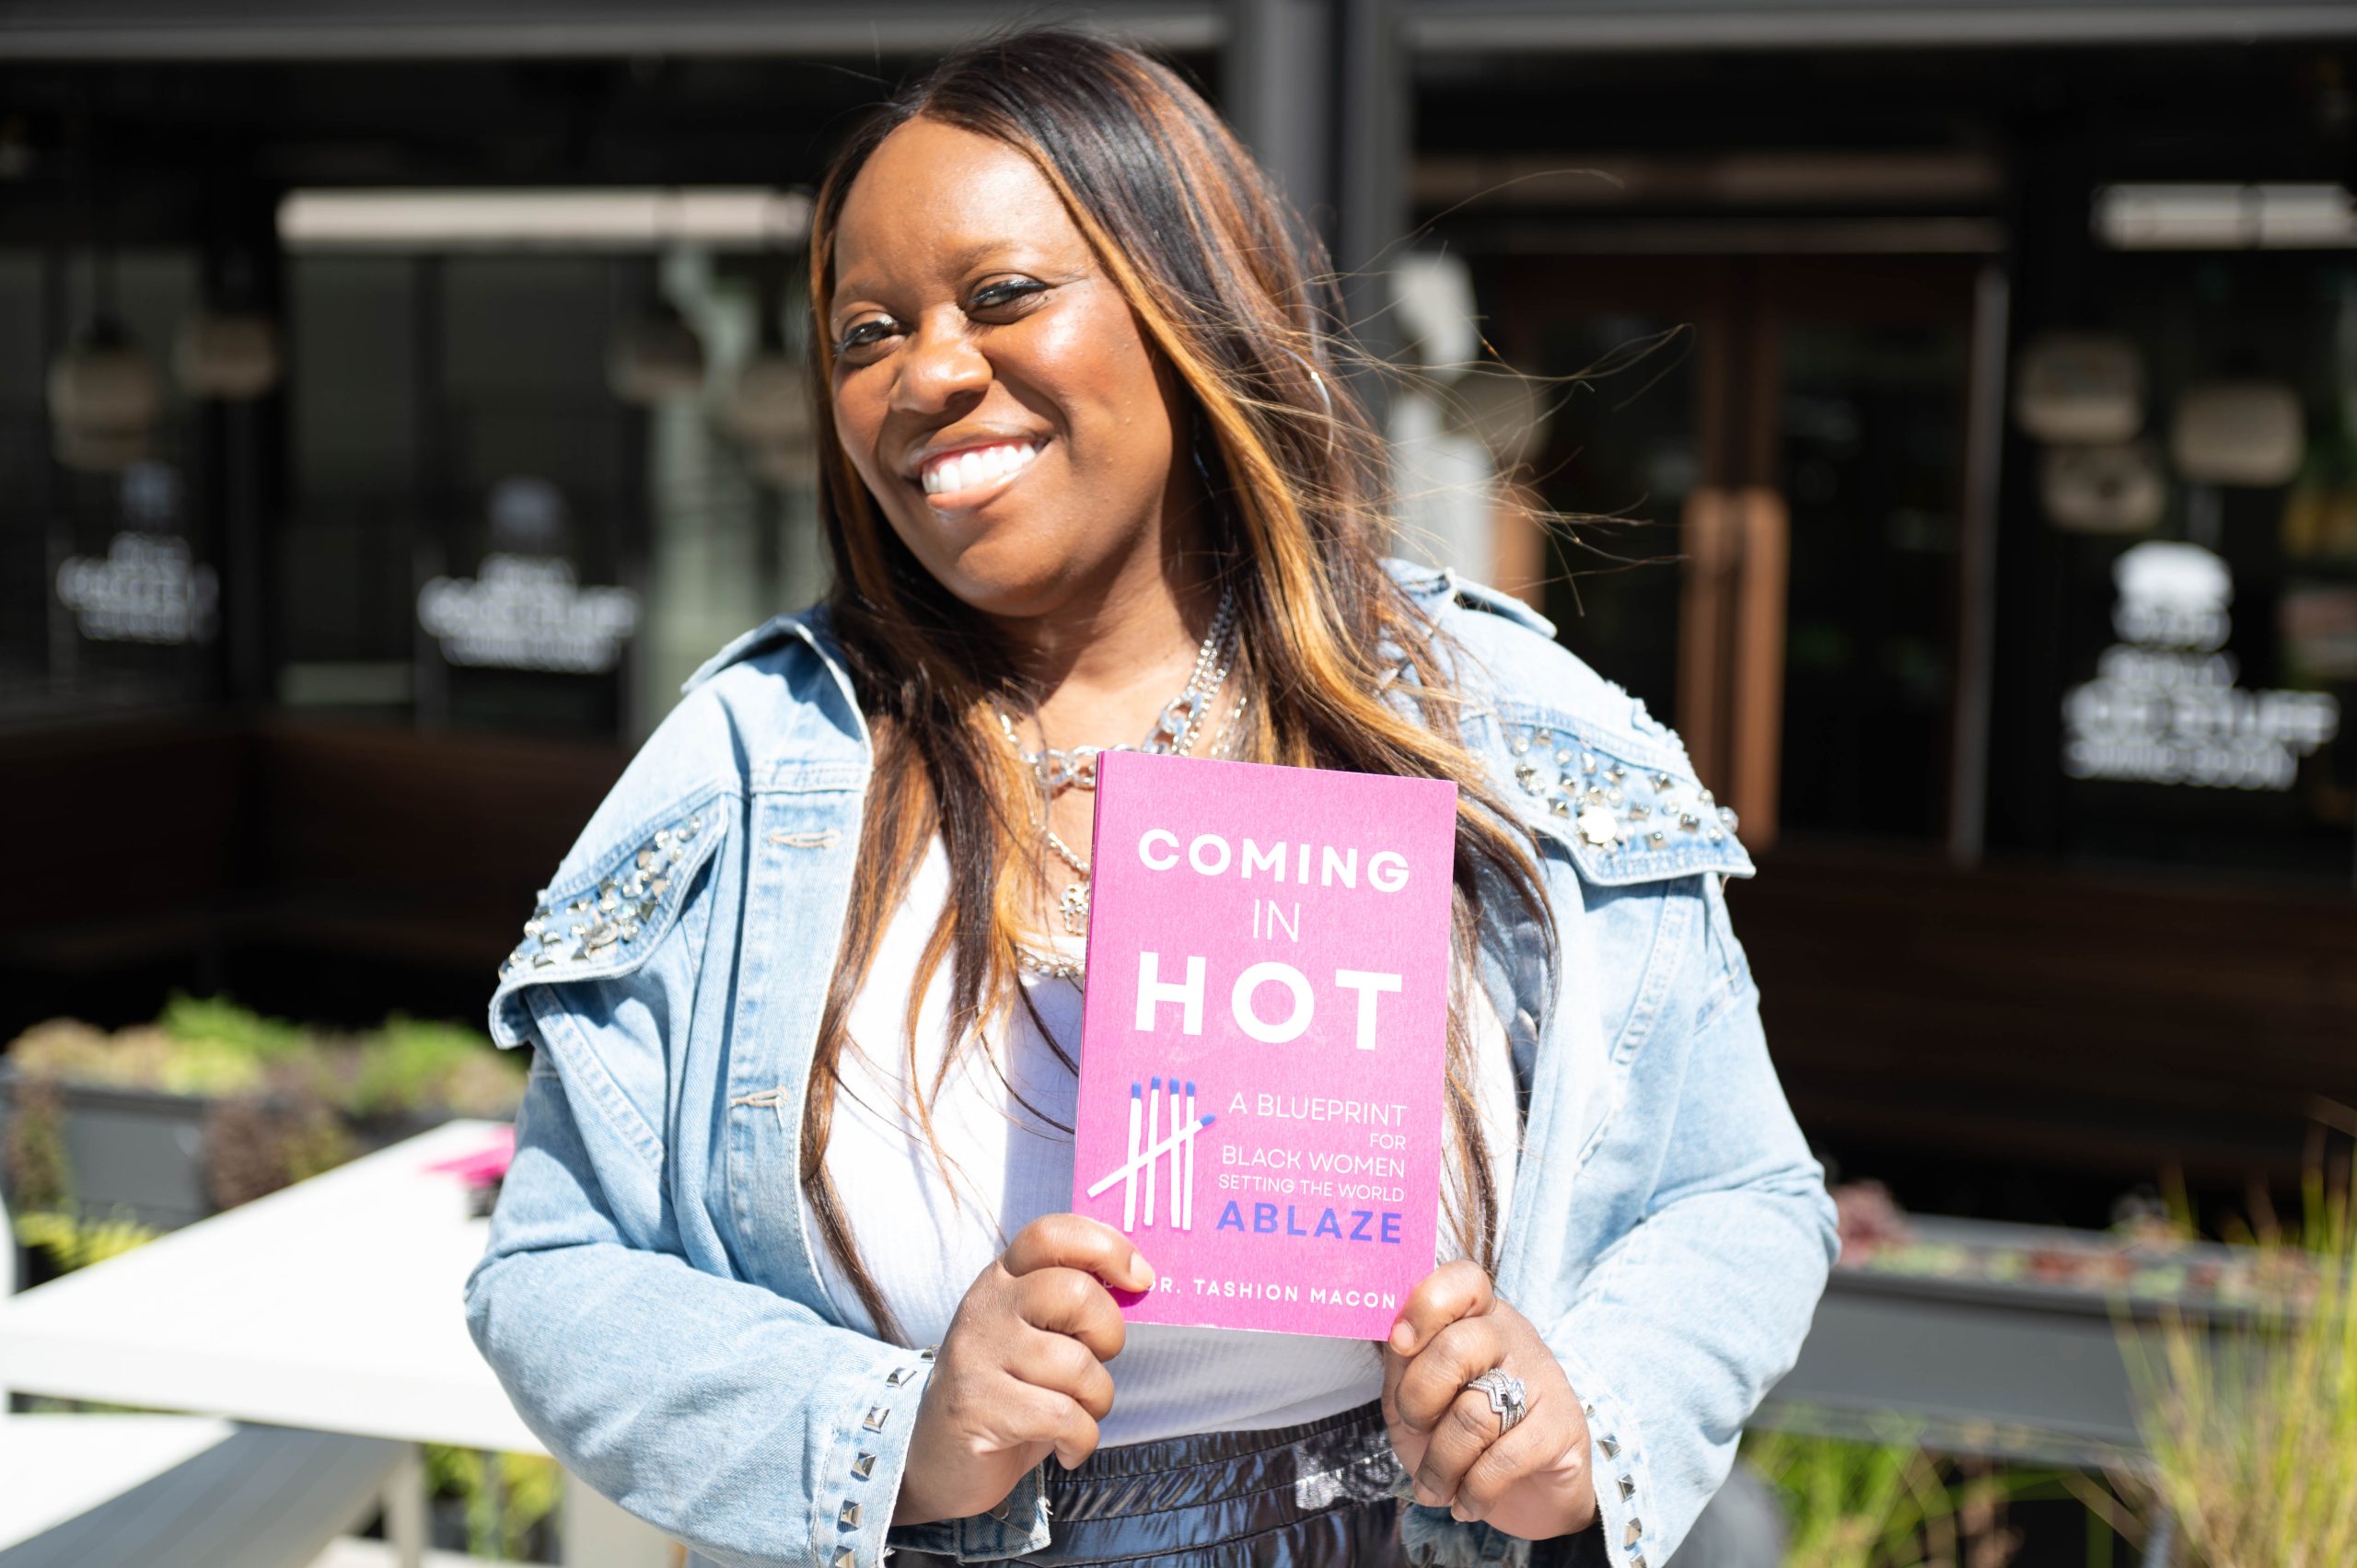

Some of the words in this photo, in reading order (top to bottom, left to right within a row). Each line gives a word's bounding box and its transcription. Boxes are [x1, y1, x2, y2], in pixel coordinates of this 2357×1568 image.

[1138, 829, 1410, 893] COMING
[1252, 899, 1300, 943] IN
[1135, 951, 1402, 1051] HOT
[1228, 1092, 1248, 1114] A
[1257, 1093, 1407, 1127] BLUEPRINT
[1369, 1132, 1407, 1151] FOR
[1222, 1144, 1302, 1170] BLACK
[1308, 1152, 1405, 1179] WOMEN
[1218, 1174, 1295, 1193] SETTING
[1300, 1179, 1333, 1197] THE
[1338, 1183, 1405, 1202] WORLD
[1216, 1200, 1402, 1244] ABLAZE
[1193, 1279, 1298, 1302] TASHION
[1310, 1287, 1396, 1309] MACON
